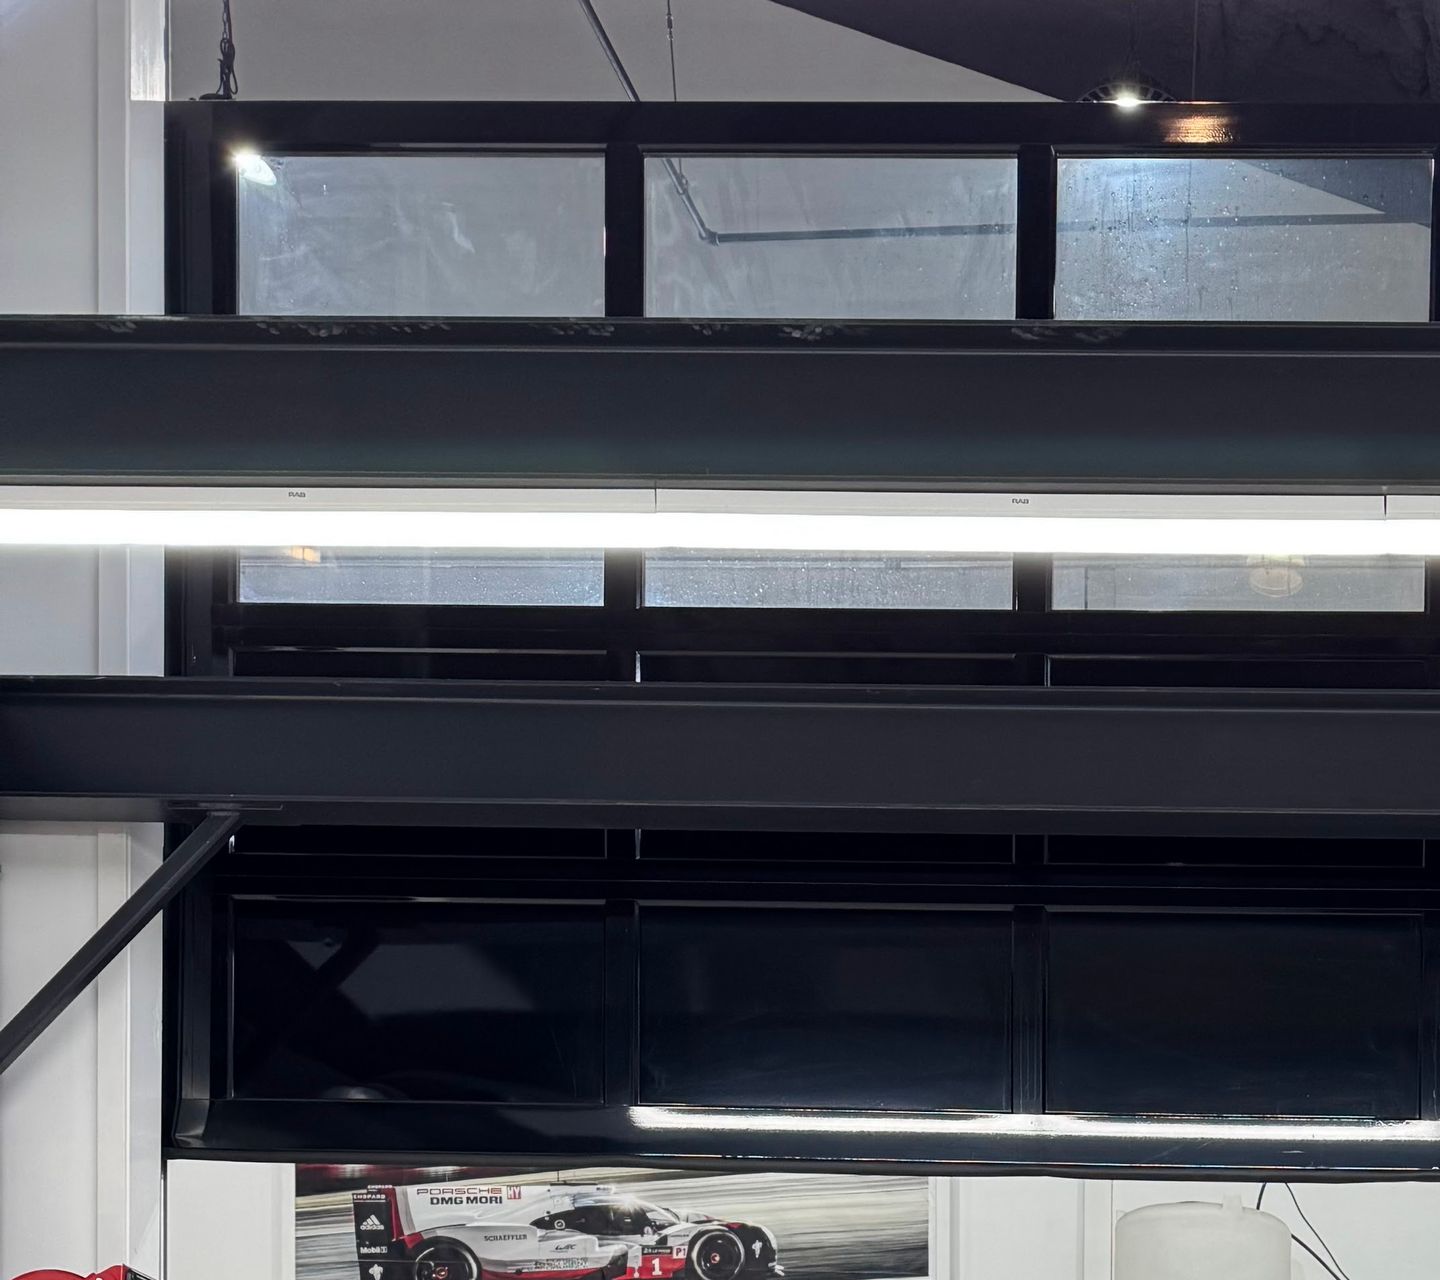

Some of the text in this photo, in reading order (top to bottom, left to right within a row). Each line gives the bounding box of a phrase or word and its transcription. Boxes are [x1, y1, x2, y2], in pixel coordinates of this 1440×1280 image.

[416, 1187, 502, 1196] PORSCHE
[430, 1196, 503, 1205] DMG MORI
[675, 1247, 687, 1257] P1
[651, 1257, 662, 1276] 1
